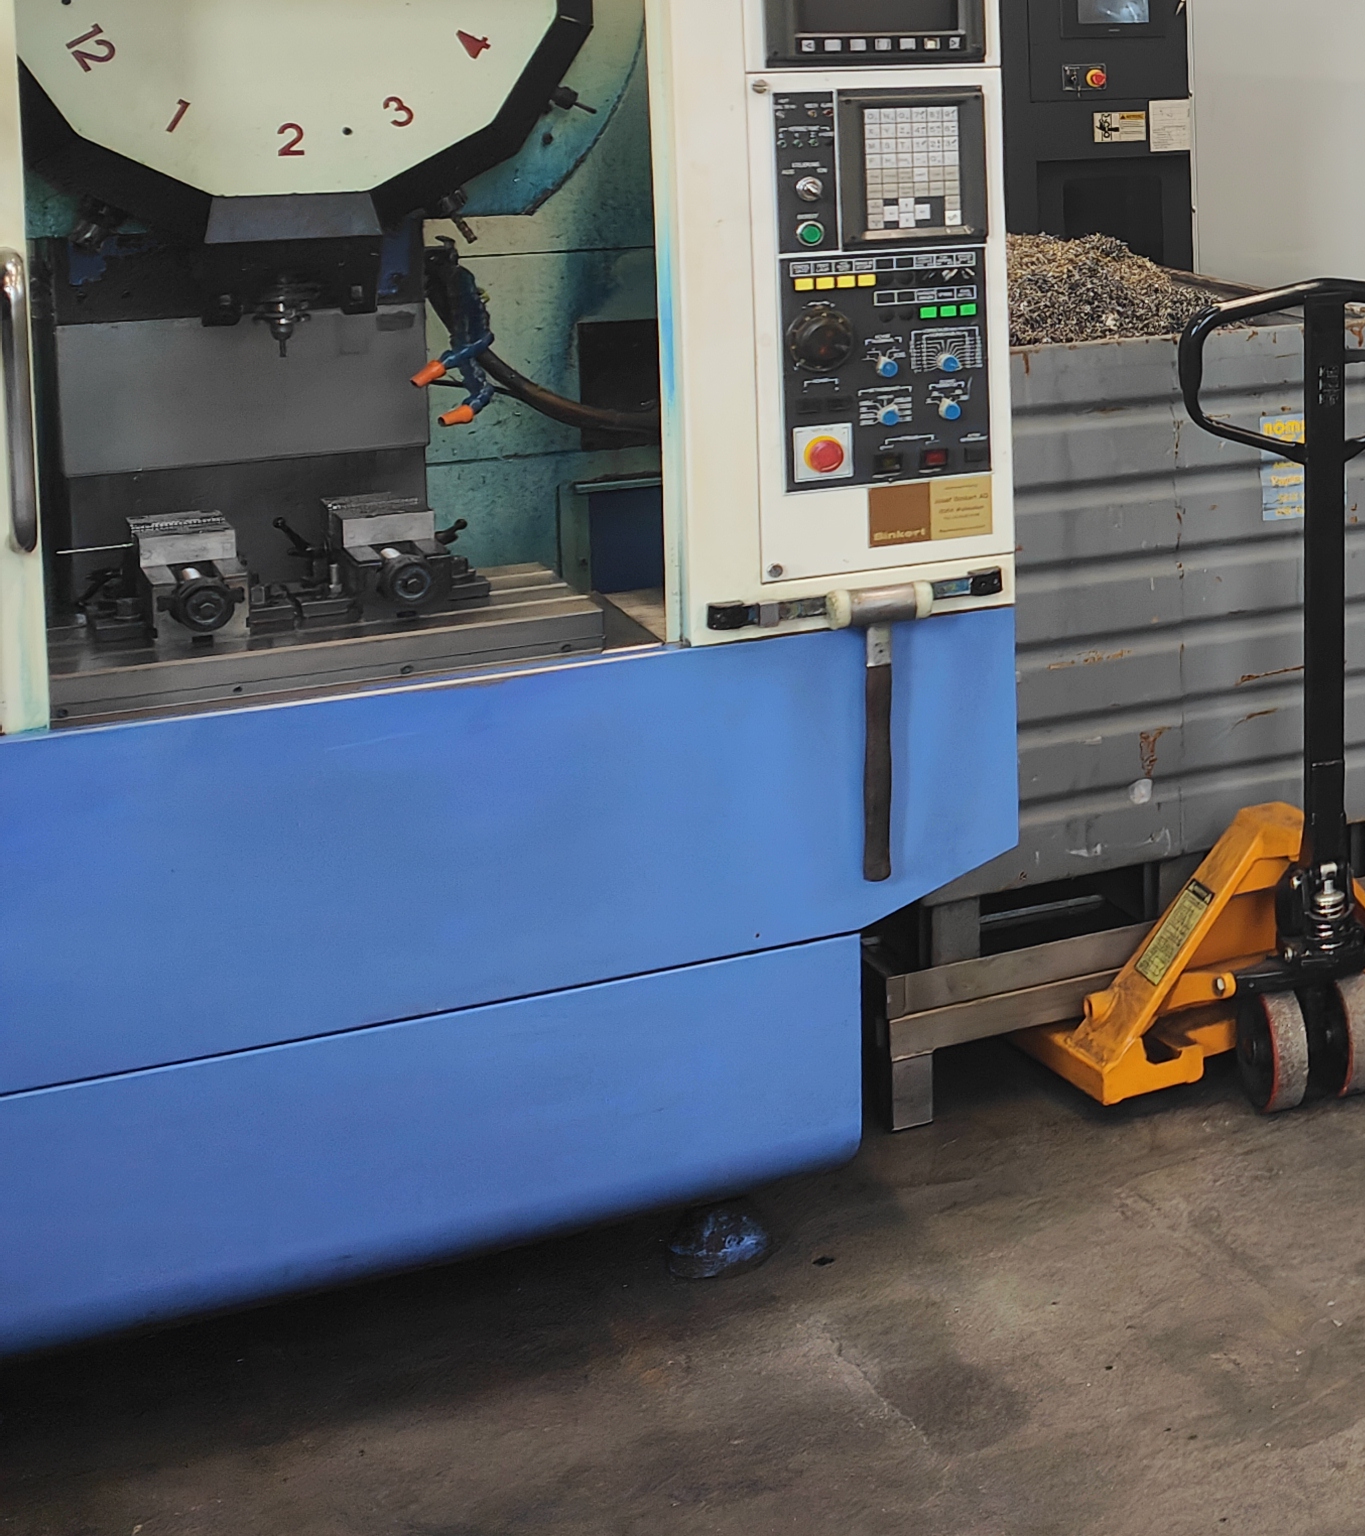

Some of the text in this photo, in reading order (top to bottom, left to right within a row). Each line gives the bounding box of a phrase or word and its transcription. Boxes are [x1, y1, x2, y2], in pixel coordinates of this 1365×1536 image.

[456, 28, 491, 60] 4
[165, 97, 191, 133] 1
[382, 95, 415, 128] 3
[277, 122, 305, 157] 2
